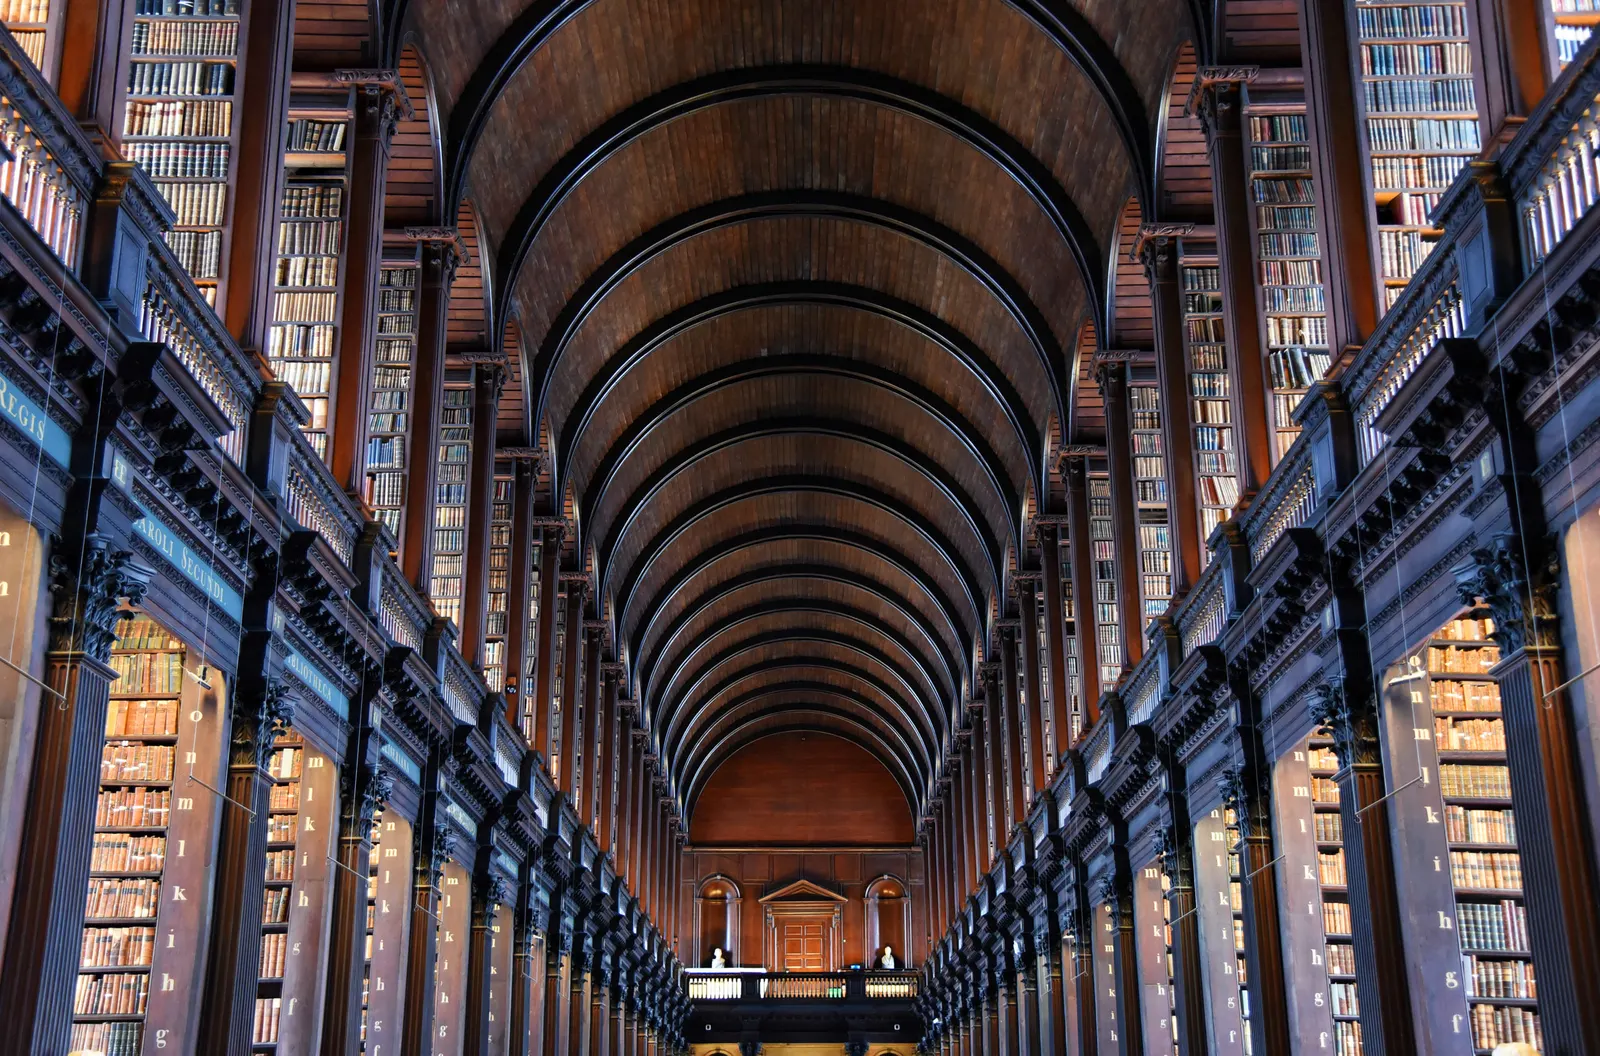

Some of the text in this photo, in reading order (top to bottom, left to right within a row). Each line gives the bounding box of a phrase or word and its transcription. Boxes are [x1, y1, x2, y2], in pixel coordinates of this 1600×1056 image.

[133, 518, 175, 558] AROLI
[1409, 655, 1421, 667] o
[288, 653, 332, 701] IBLIOTHECA
[1410, 690, 1423, 703] n
[189, 709, 202, 722] o
[1413, 728, 1430, 740] m
[185, 751, 197, 764] n
[307, 756, 323, 768] m
[1293, 751, 1305, 761] n
[1292, 786, 1309, 796] m
[177, 797, 193, 809] m
[1210, 809, 1220, 818] n
[1424, 807, 1439, 823] k
[304, 817, 315, 831] k
[386, 821, 396, 831] n
[1210, 831, 1223, 841] m
[384, 848, 397, 857] m
[1144, 867, 1158, 878] m
[1303, 865, 1316, 880] k
[172, 886, 186, 900] k
[297, 891, 308, 906] h
[1218, 892, 1228, 905] k
[381, 899, 390, 912] k
[1437, 911, 1452, 929] h
[444, 930, 454, 941] k
[1153, 925, 1162, 936] k
[291, 942, 301, 955] g
[1310, 949, 1322, 965] h
[1223, 961, 1233, 974] h
[161, 973, 174, 991] h
[375, 977, 385, 990] h
[1445, 972, 1458, 988] g
[1156, 982, 1166, 995] h
[440, 991, 449, 1003] h
[1227, 996, 1236, 1008] g
[1314, 993, 1324, 1006] g
[287, 998, 297, 1015] f
[374, 1020, 383, 1031] g
[1452, 1014, 1462, 1033] f
[439, 1025, 448, 1037] g
[1229, 1030, 1237, 1042] f
[155, 1030, 169, 1048] g
[1319, 1032, 1329, 1047] f
